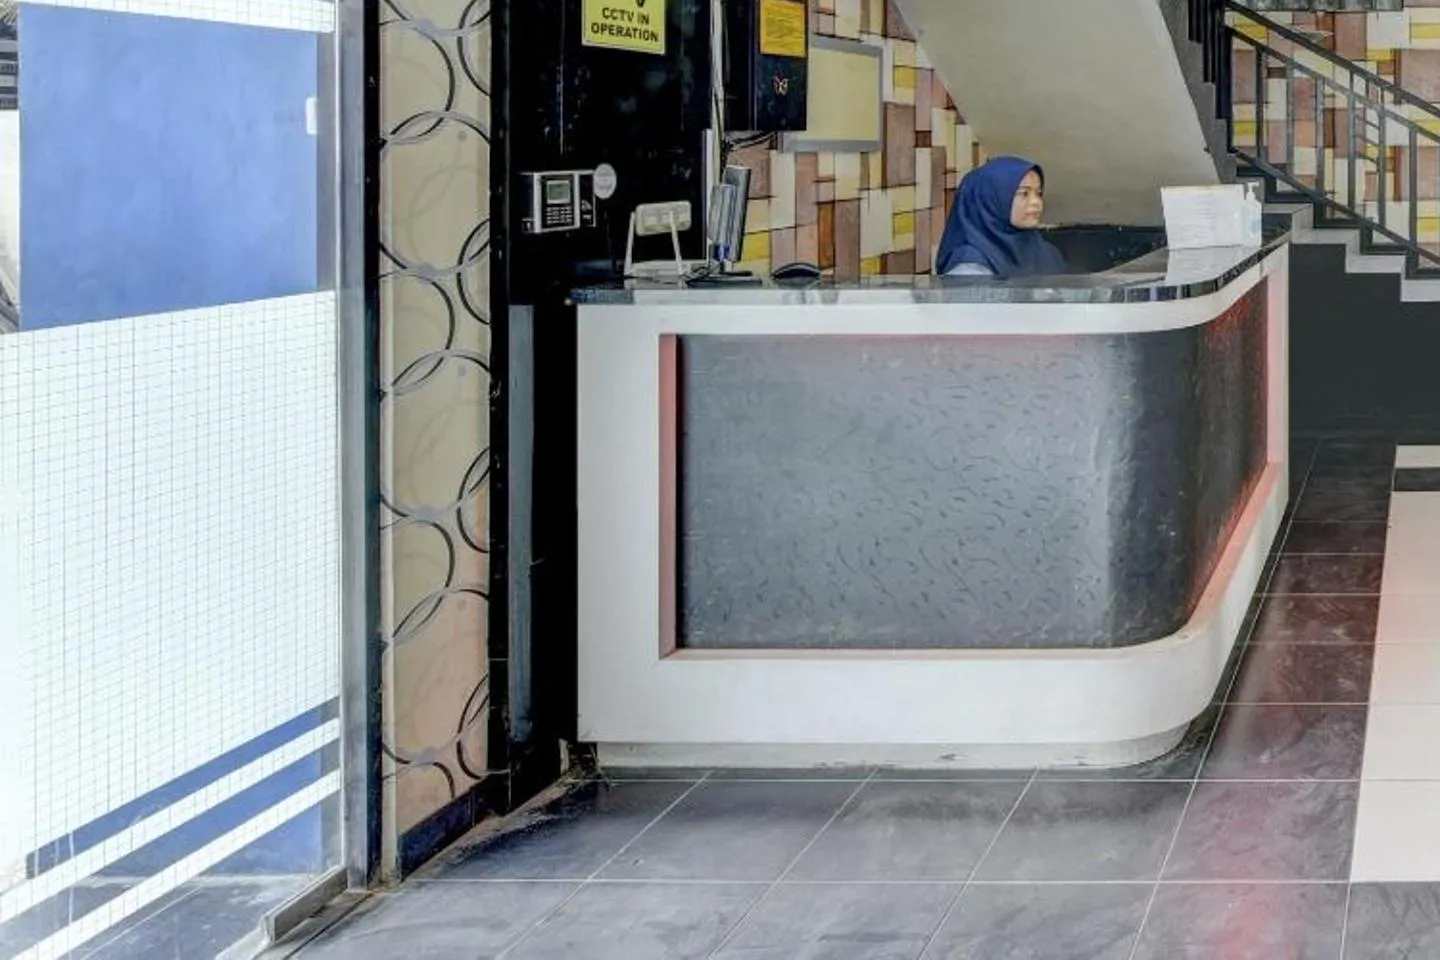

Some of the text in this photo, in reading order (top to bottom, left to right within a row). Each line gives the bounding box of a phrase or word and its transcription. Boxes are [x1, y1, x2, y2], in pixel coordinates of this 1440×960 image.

[602, 7, 650, 26] CCTV IN
[591, 22, 659, 43] OPERATION
